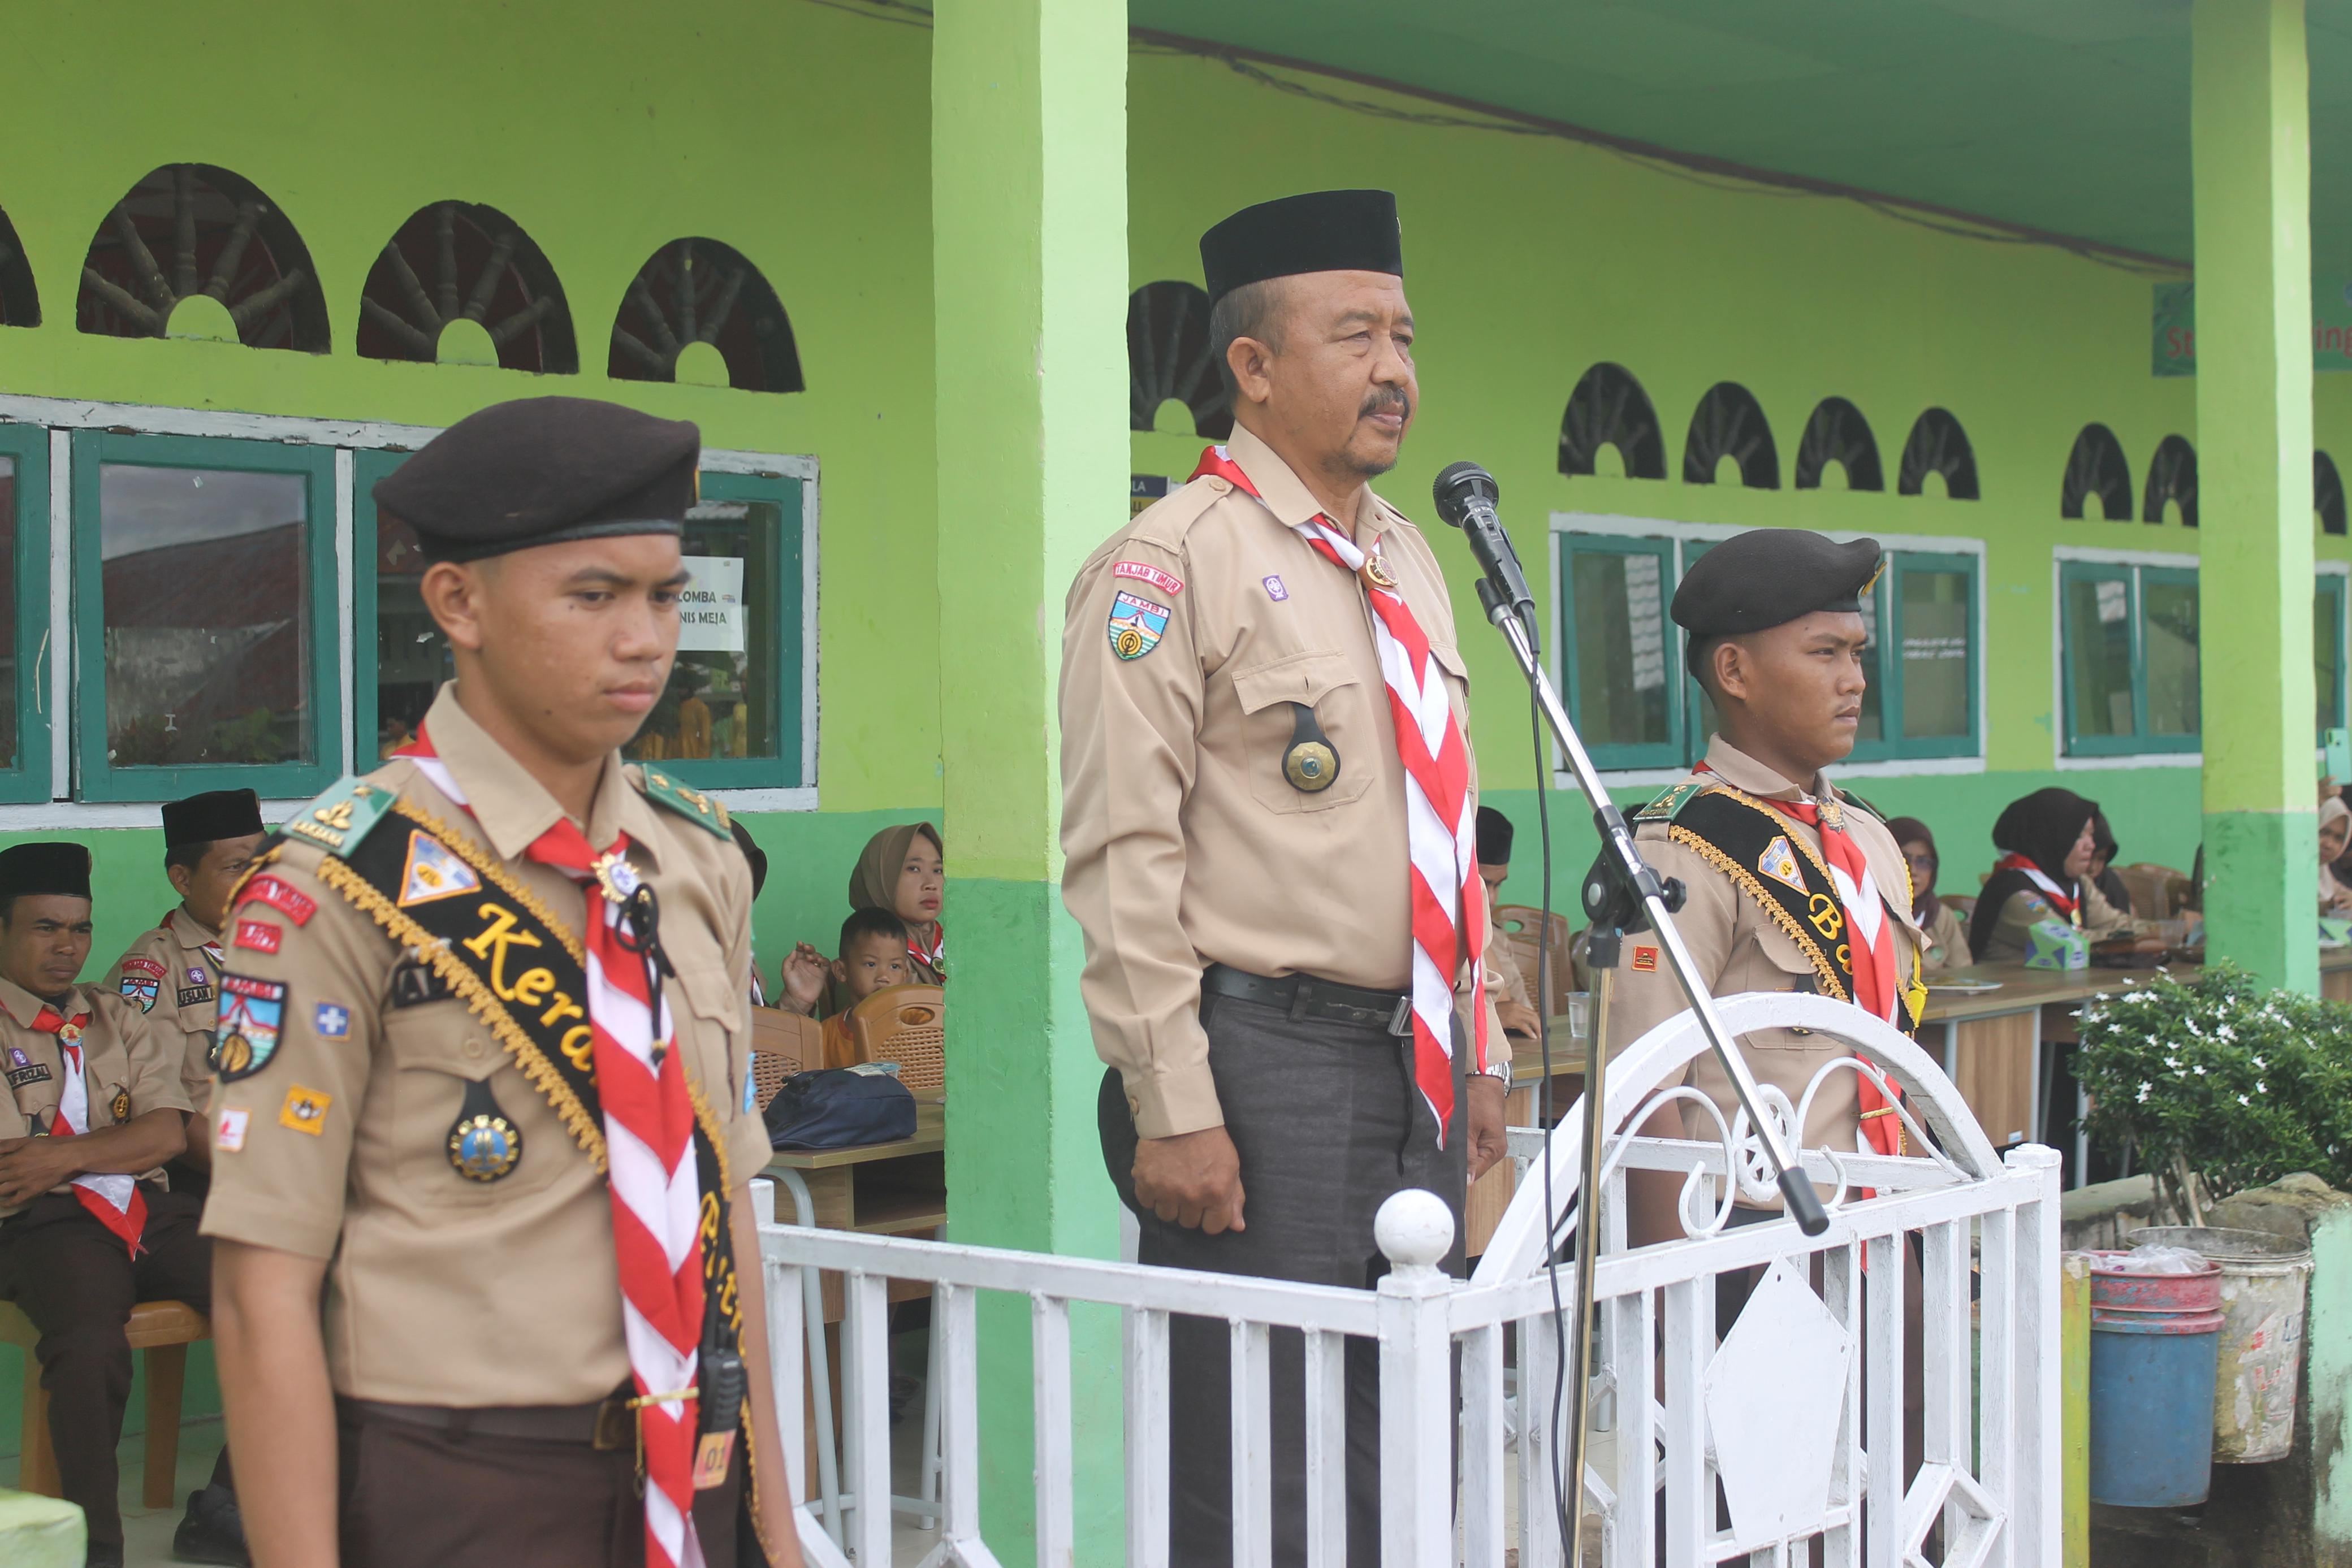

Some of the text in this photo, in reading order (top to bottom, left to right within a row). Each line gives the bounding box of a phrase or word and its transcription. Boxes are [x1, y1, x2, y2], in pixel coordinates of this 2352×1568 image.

[1116, 564, 1179, 592] TANJAB TIMUR
[1123, 596, 1164, 616] JAMBI
[699, 612, 727, 626] MEJA
[462, 903, 596, 1084] Kera
